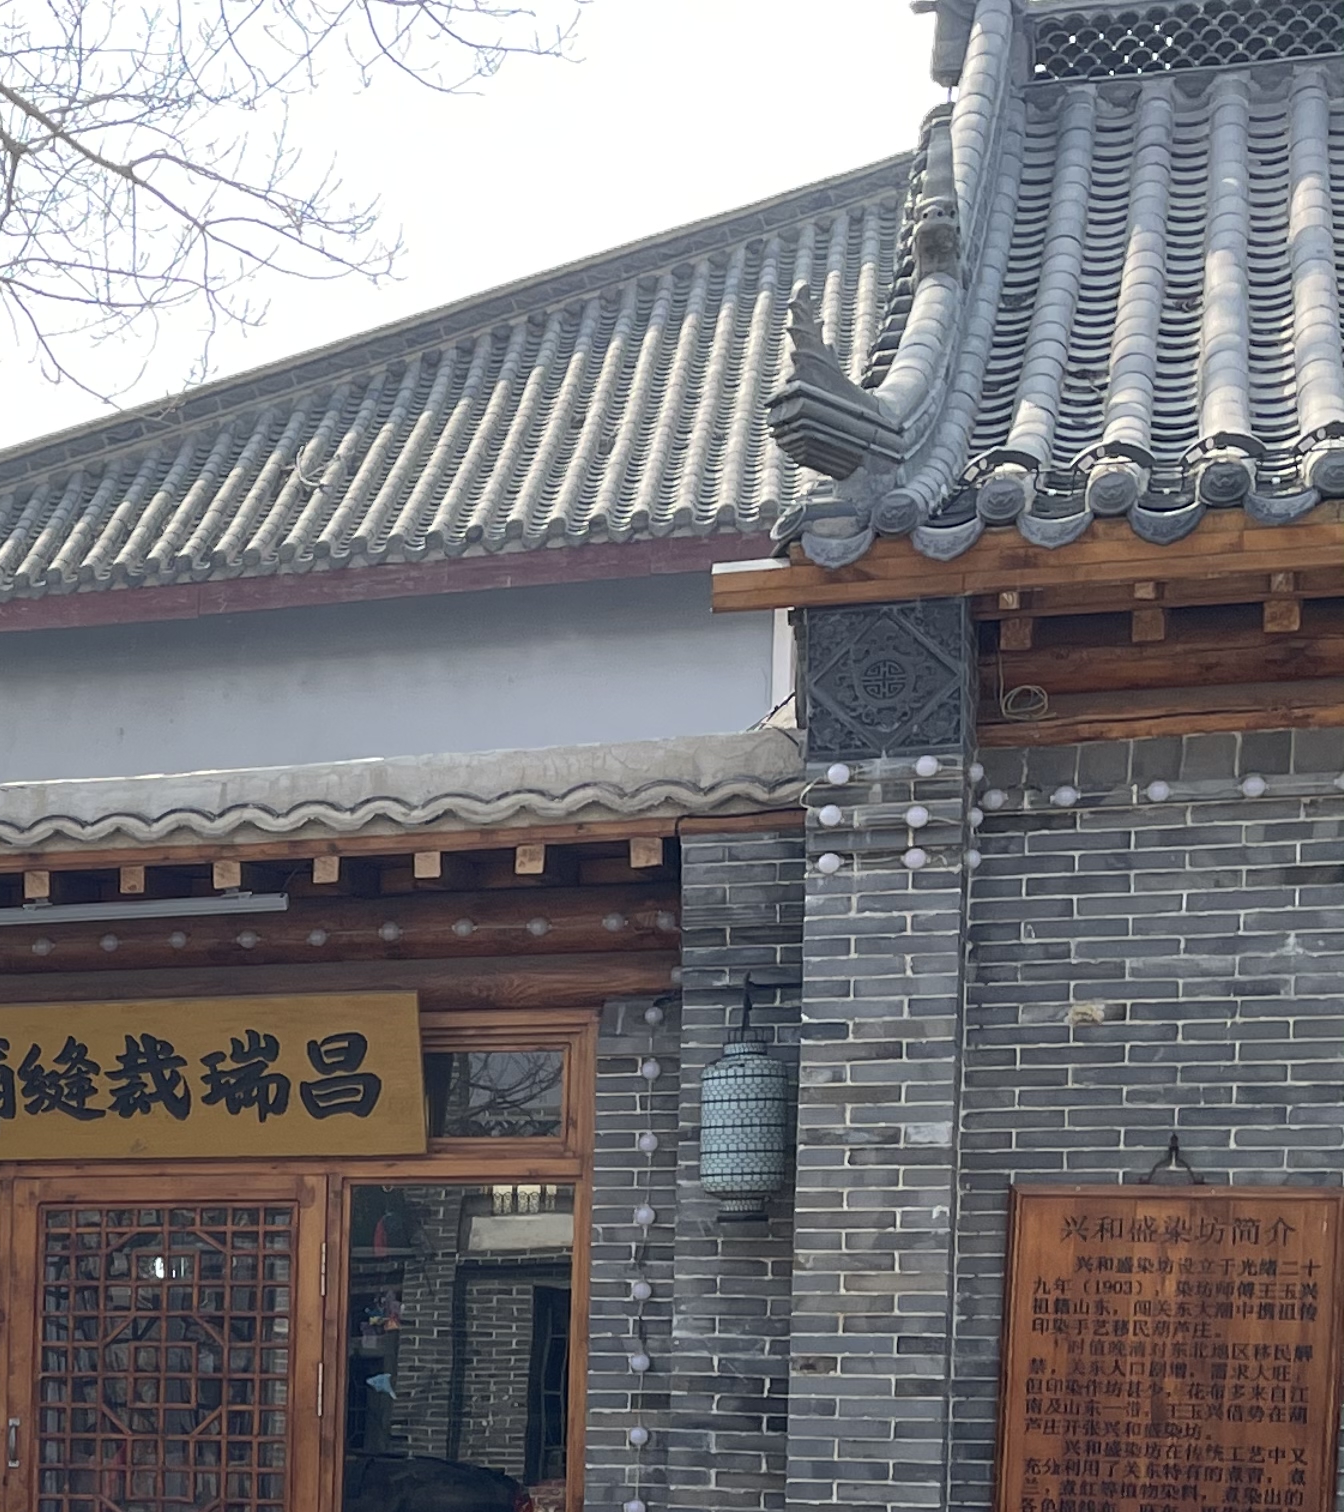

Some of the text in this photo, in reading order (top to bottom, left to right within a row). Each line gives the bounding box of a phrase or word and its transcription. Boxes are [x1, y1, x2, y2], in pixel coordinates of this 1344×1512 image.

[1060, 1214, 1296, 1247] 兴和盛染坊简介
